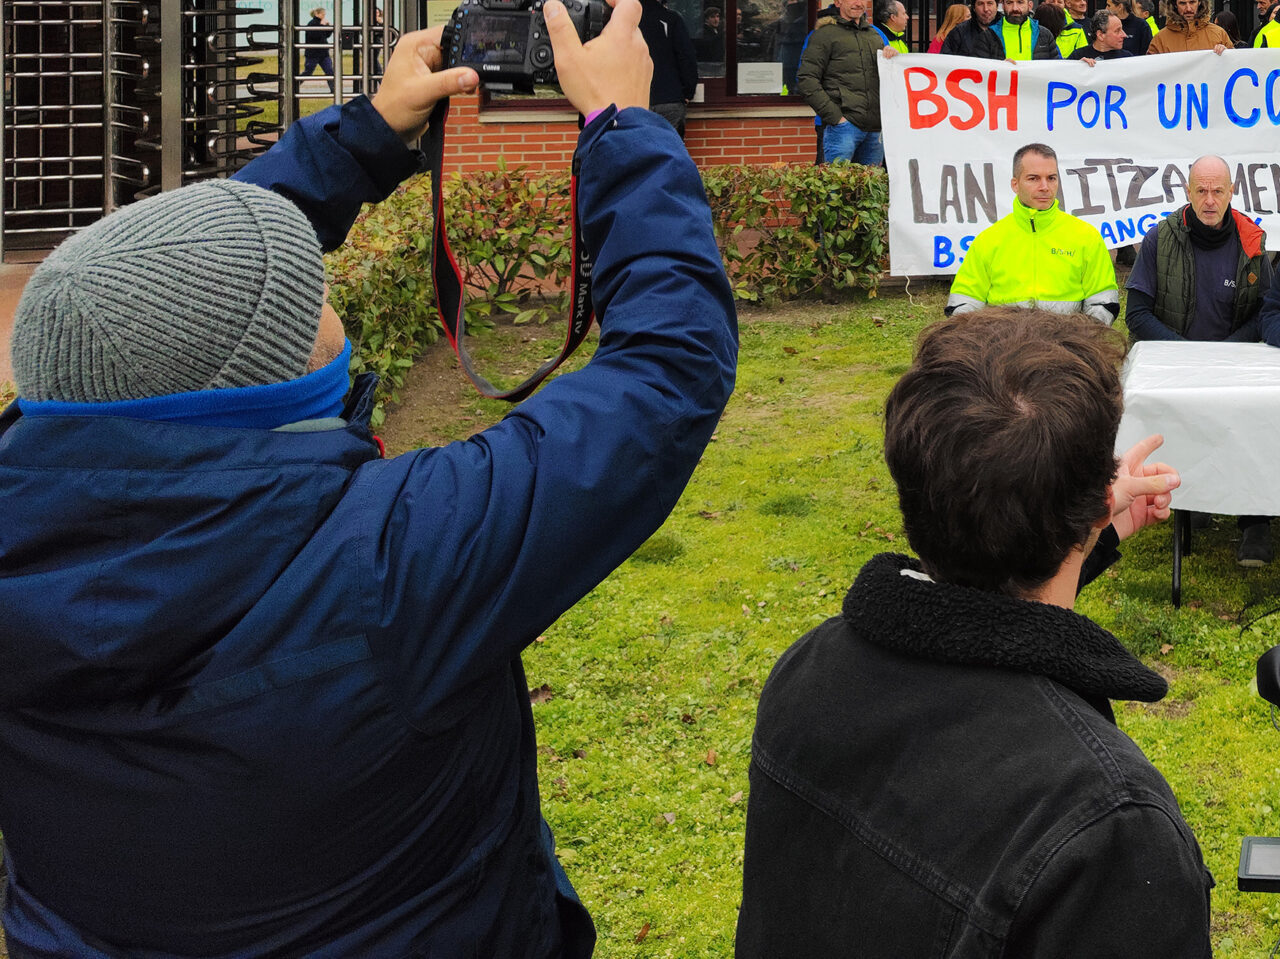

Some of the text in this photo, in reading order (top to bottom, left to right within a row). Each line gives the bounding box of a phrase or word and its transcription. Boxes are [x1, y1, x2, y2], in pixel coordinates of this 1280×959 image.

[482, 63, 500, 71] Canon
[904, 67, 1018, 131] BSH
[1047, 81, 1127, 131] POR
[1157, 83, 1208, 131] UN
[908, 158, 998, 224] LAN
[576, 283, 588, 318] Mark
